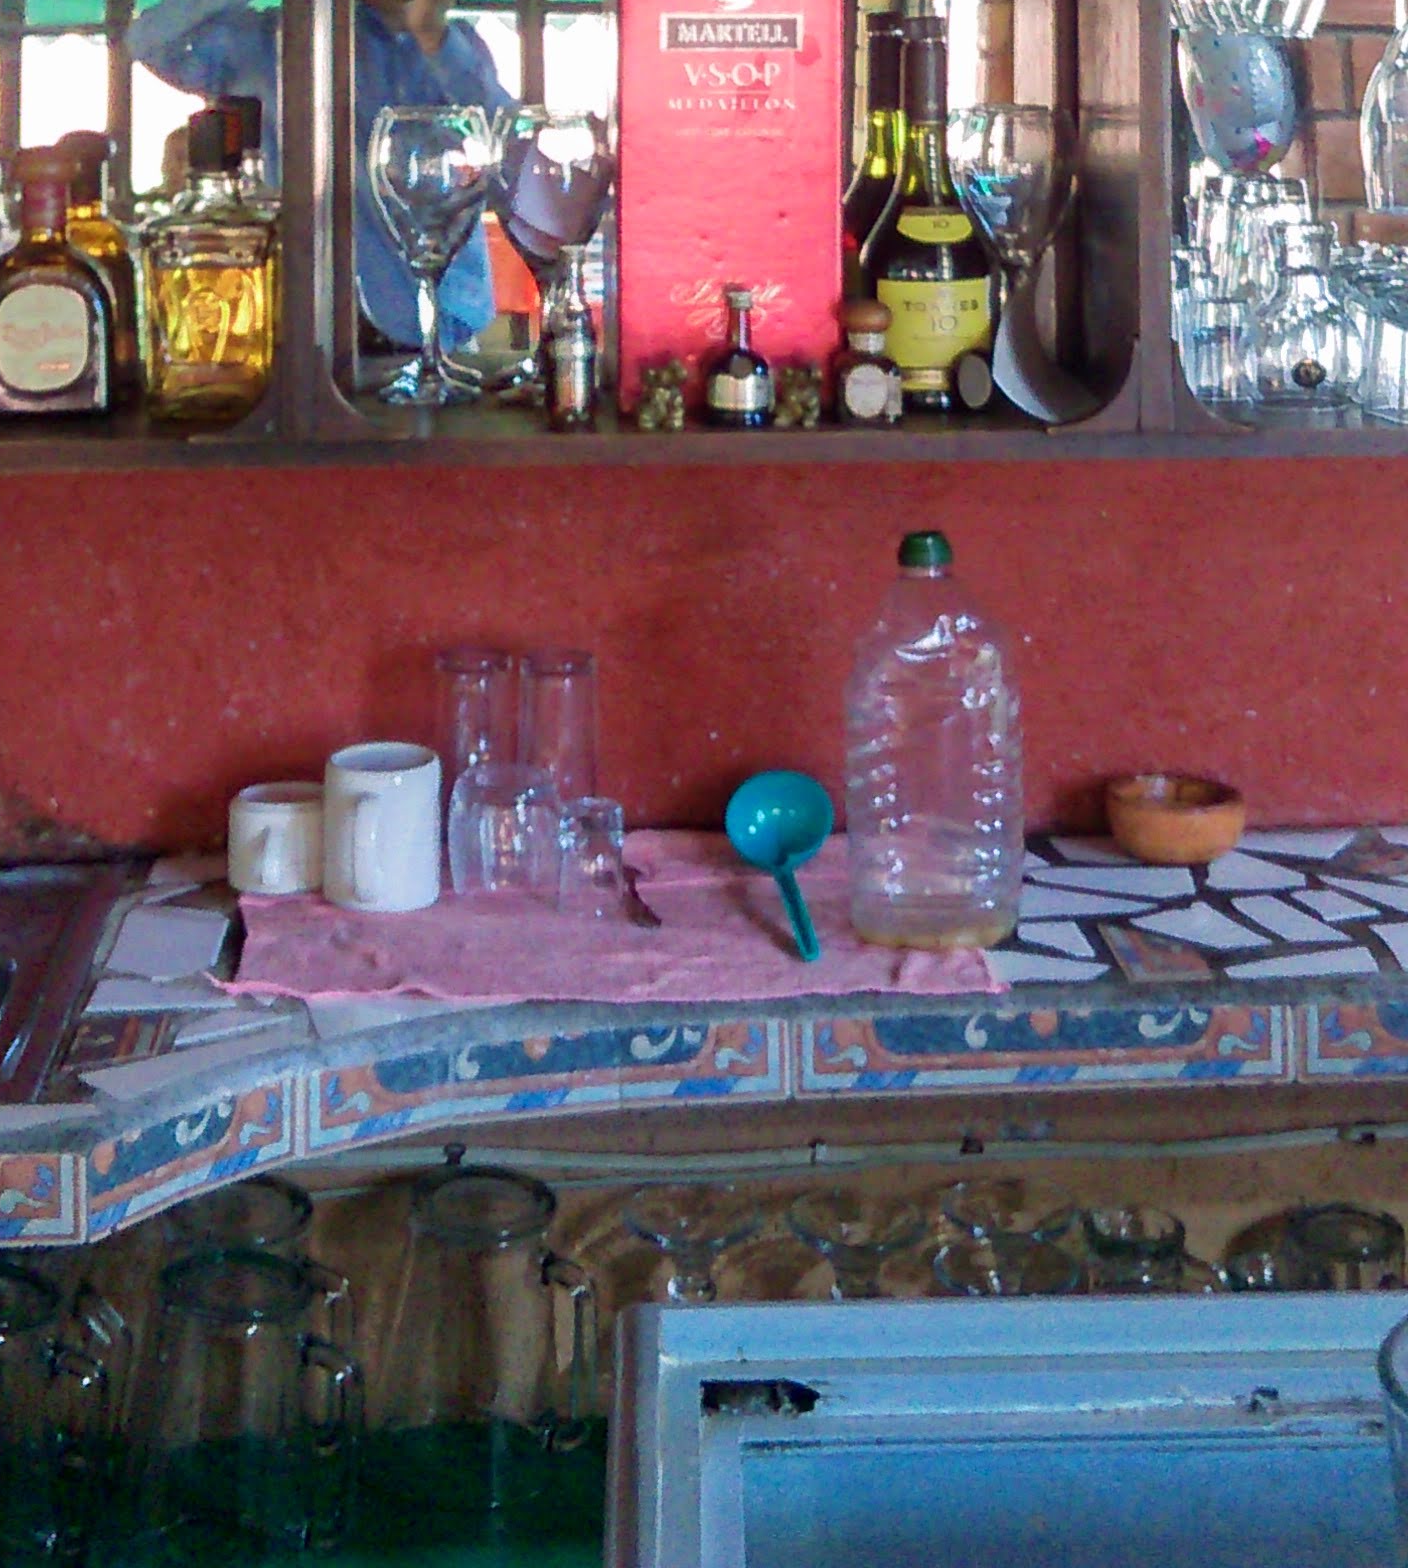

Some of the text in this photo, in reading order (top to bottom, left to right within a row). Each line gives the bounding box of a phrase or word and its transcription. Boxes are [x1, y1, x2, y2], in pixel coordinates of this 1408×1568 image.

[677, 21, 789, 44] MARTELL
[903, 298, 980, 312] TOES
[931, 313, 958, 332] 10
